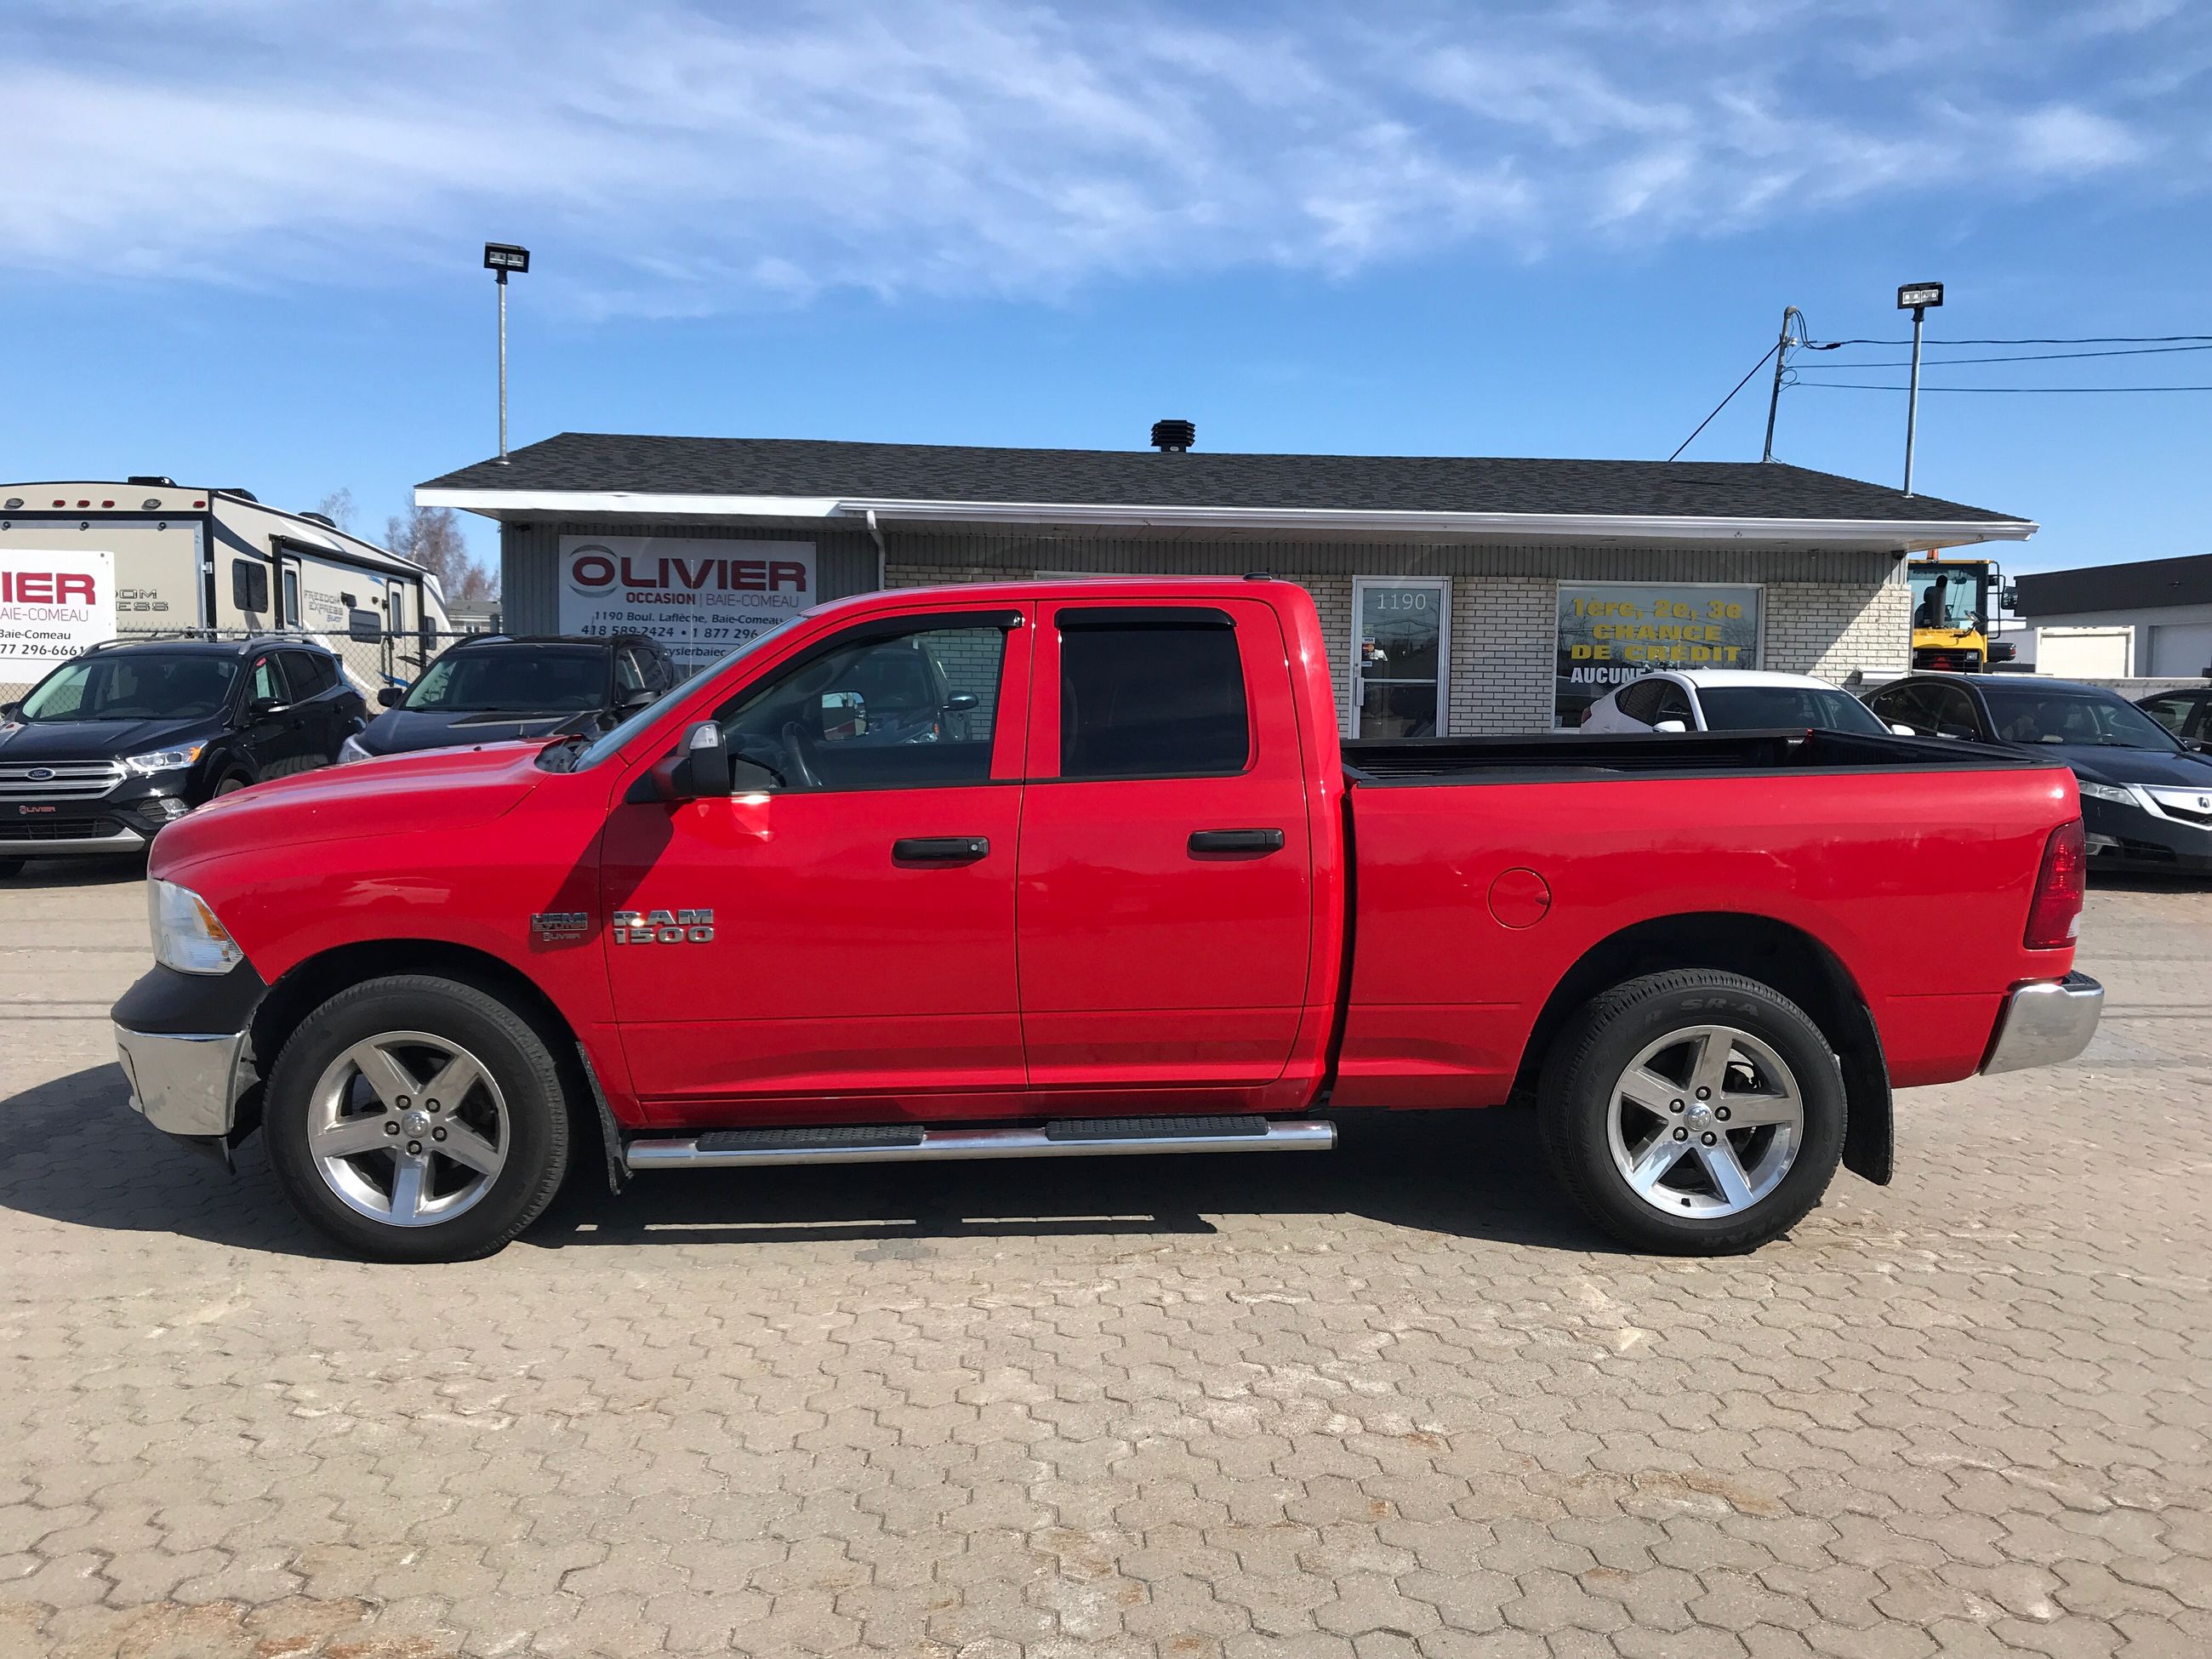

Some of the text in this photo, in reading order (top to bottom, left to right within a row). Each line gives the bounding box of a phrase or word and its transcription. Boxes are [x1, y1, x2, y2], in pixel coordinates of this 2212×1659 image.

[573, 556, 807, 591] OLIVIER
[626, 592, 799, 607] OCCASION BAIE-COMEAU
[1377, 593, 1426, 610] 1190
[1573, 597, 1742, 621] 1ère, 2e, 3e
[595, 612, 623, 620] 1190
[627, 613, 654, 622] Boul.
[659, 613, 707, 624] Laflèche,
[582, 625, 607, 636] 418
[612, 625, 675, 637] 589-2424
[693, 628, 698, 637] 1
[704, 629, 728, 638] 877
[1593, 624, 1722, 641] CHANCE
[1571, 641, 1742, 661] DE CRÉDIT
[19, 806, 55, 814] OLIVIER
[532, 913, 588, 924] HEMI
[613, 909, 714, 926] RAM
[614, 926, 714, 944] 1500
